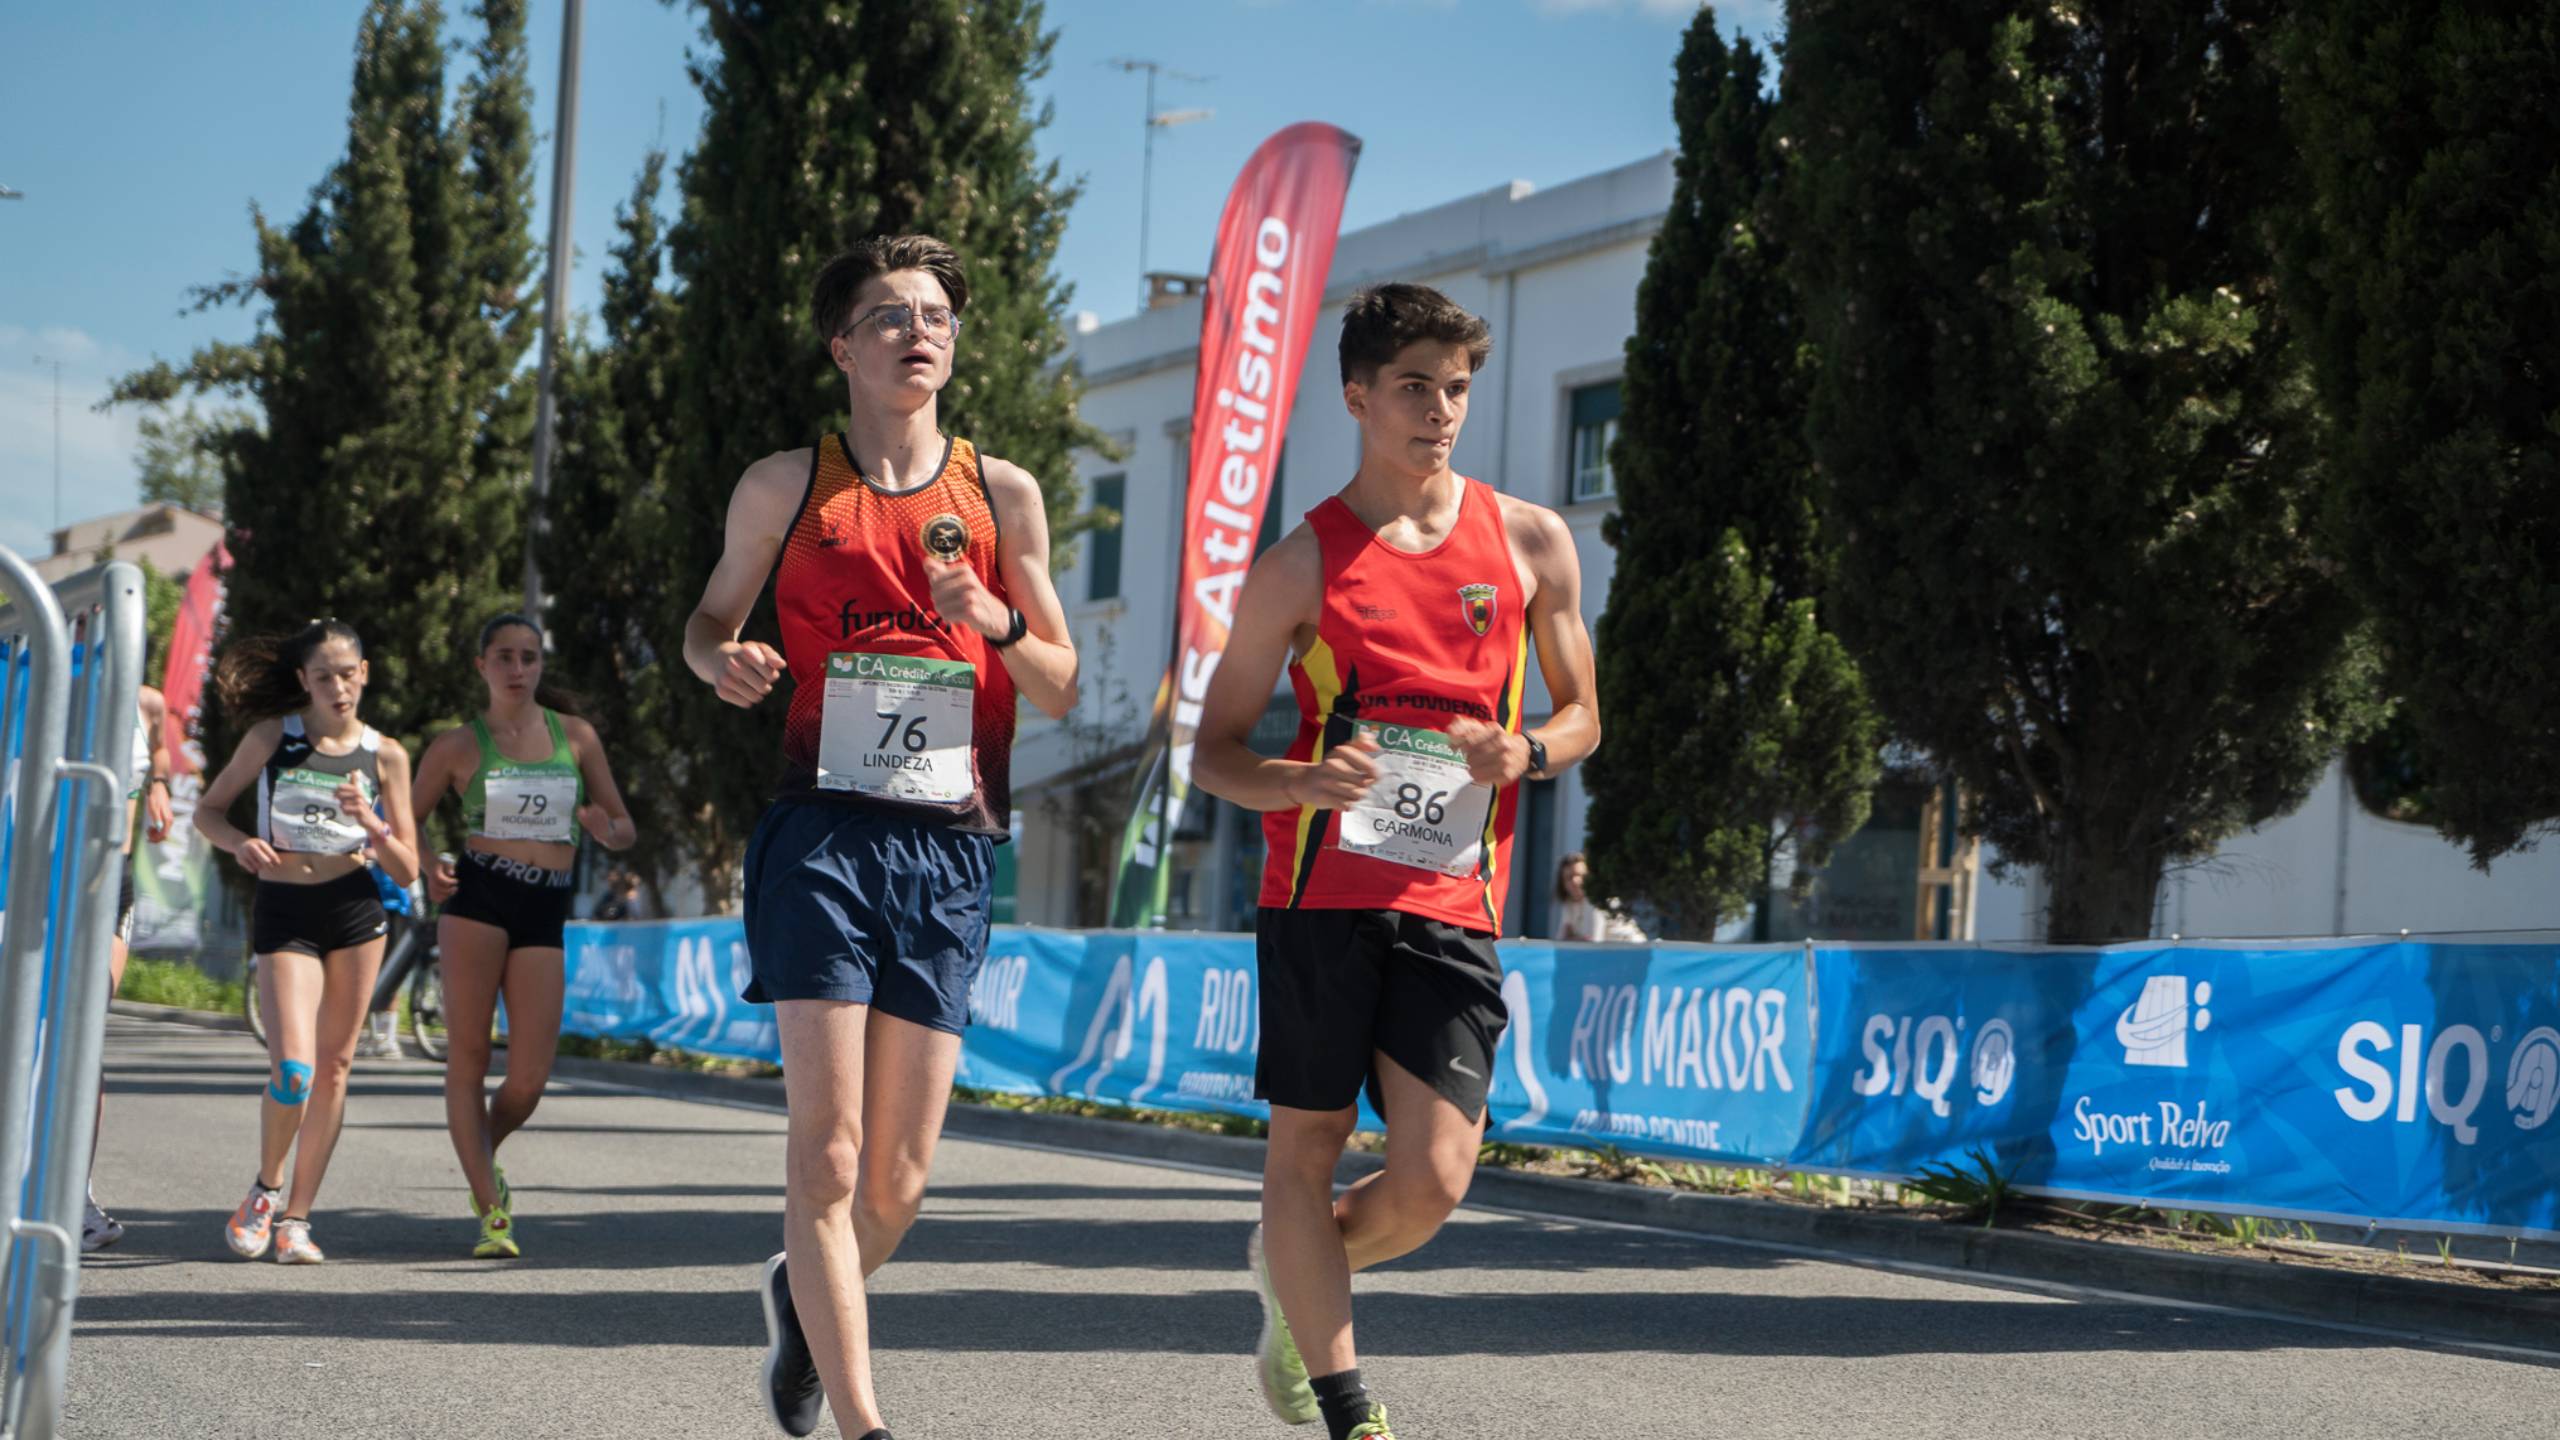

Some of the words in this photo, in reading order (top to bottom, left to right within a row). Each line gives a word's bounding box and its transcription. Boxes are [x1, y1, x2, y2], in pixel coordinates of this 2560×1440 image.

[1194, 216, 1290, 631] Atletismo
[857, 656, 886, 676] CA
[876, 712, 928, 752] 76
[1383, 727, 1412, 748] CA
[863, 753, 933, 772] LINDEZA
[517, 794, 548, 815] 79
[1394, 783, 1449, 825] 86
[1373, 818, 1454, 847] CARMONA
[491, 855, 544, 884] PRO
[1194, 968, 1250, 1053] RIO
[1570, 983, 1638, 1084] RIO
[1643, 985, 1794, 1092] MAIOR
[2074, 1096, 2153, 1156] Sport
[2158, 1100, 2231, 1149] Relva
